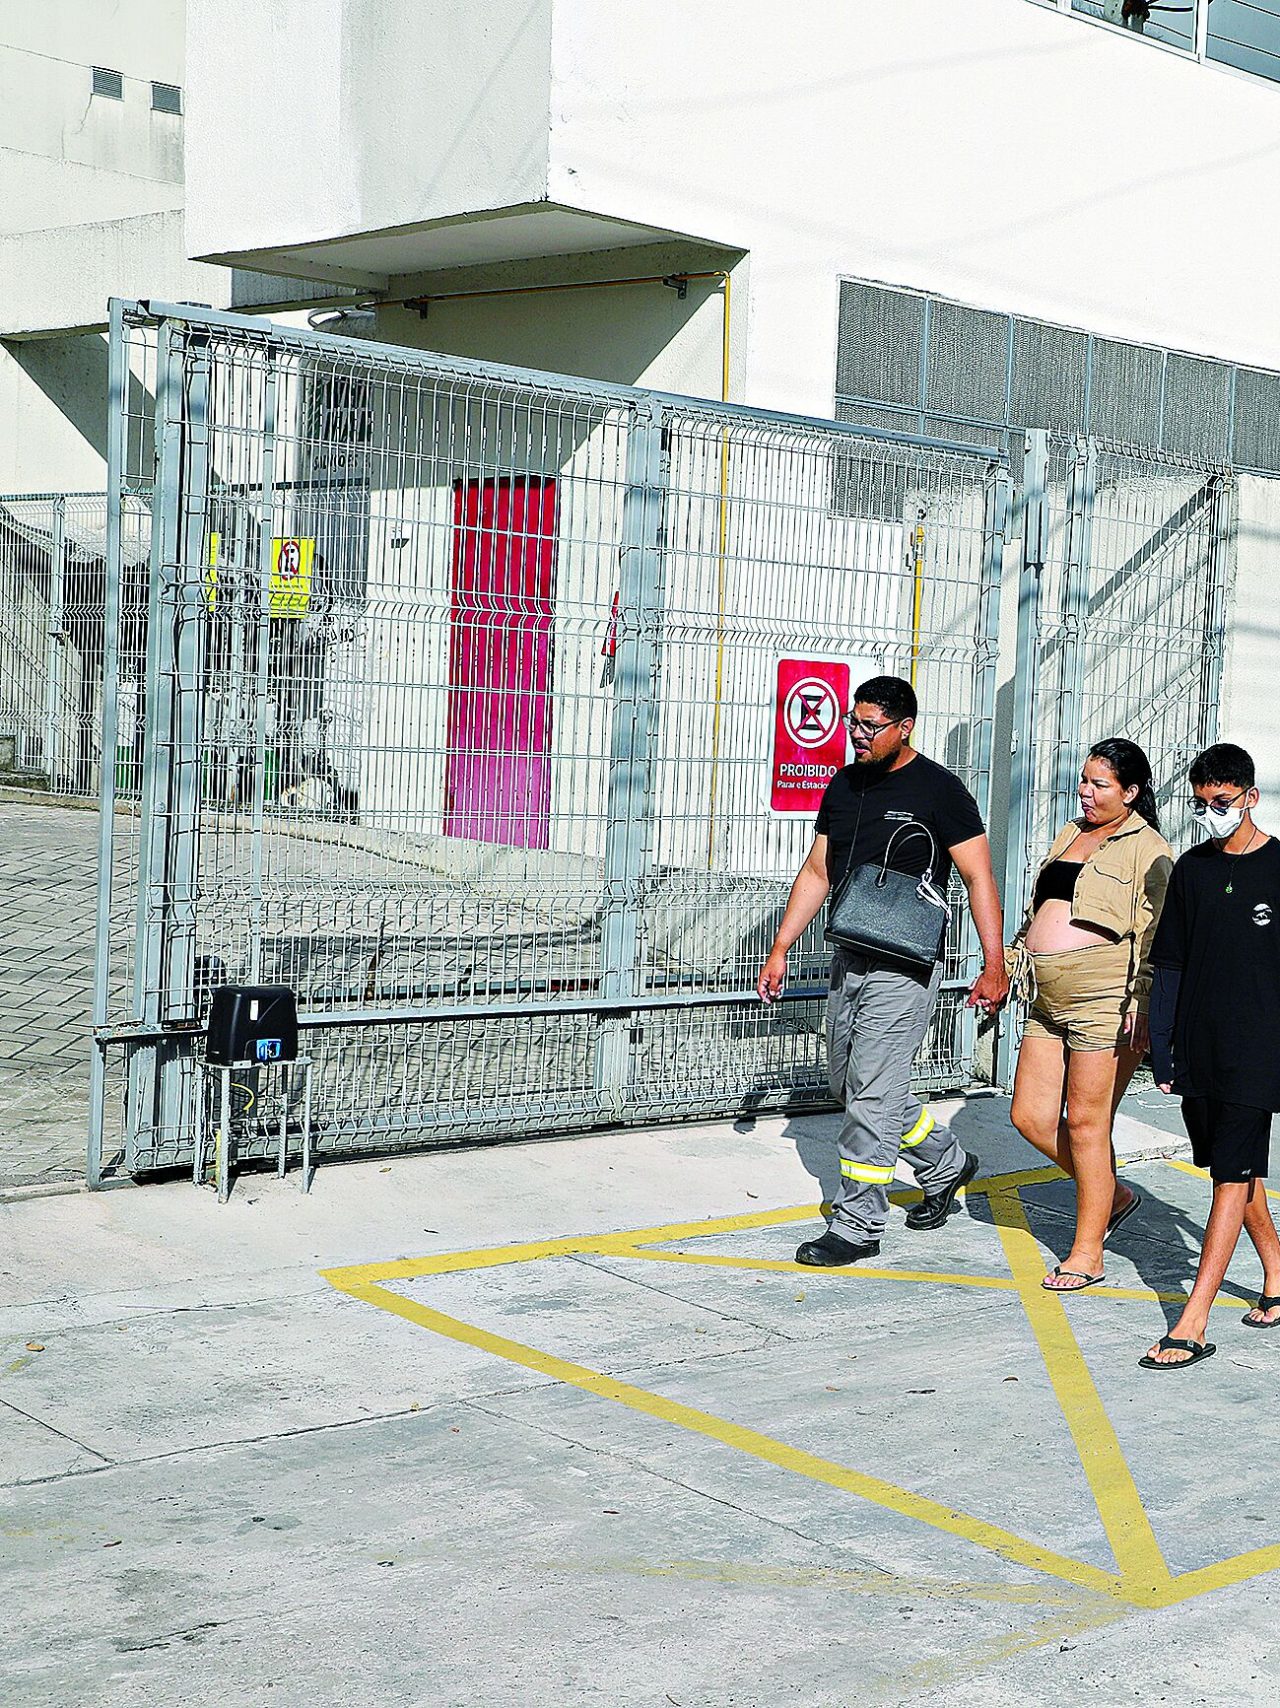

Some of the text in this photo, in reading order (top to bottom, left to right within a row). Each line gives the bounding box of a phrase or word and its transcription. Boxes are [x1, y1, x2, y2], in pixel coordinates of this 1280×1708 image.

[779, 763, 838, 778] PROIBIDO
[777, 780, 795, 789] Parar
[801, 780, 829, 790] Estacio
